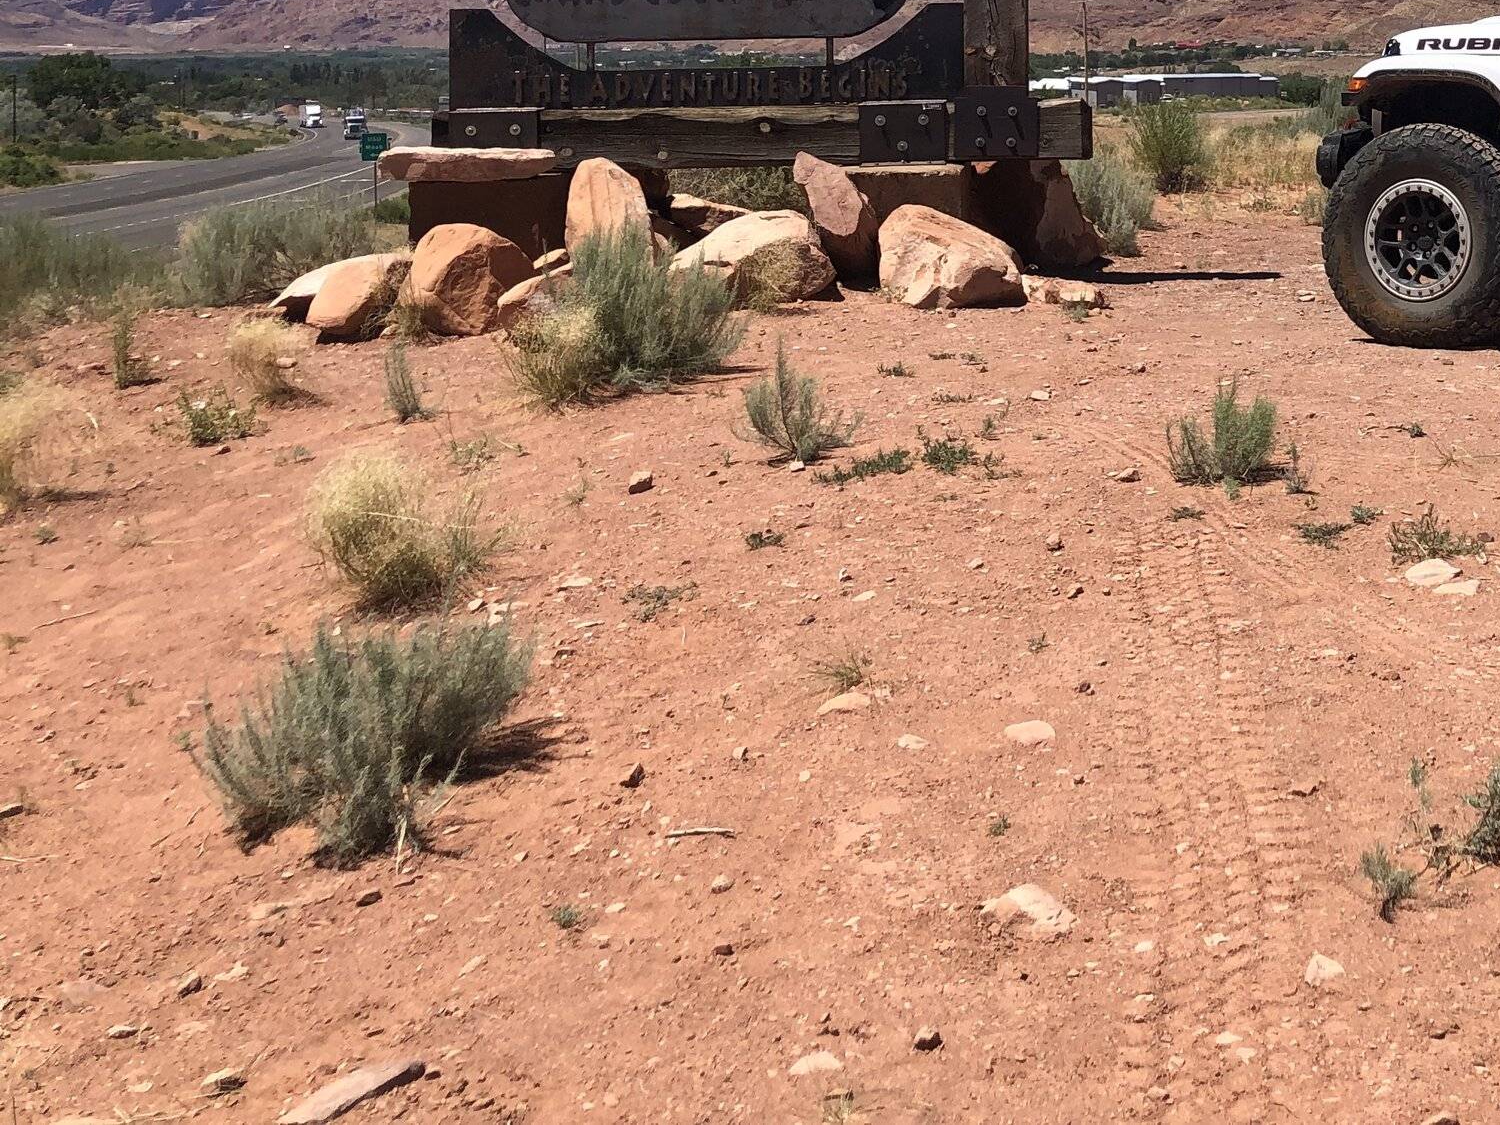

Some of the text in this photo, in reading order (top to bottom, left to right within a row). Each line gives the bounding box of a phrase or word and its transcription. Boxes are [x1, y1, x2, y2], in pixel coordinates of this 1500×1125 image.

[513, 69, 908, 104] THE ADVENTURE BEGINS
